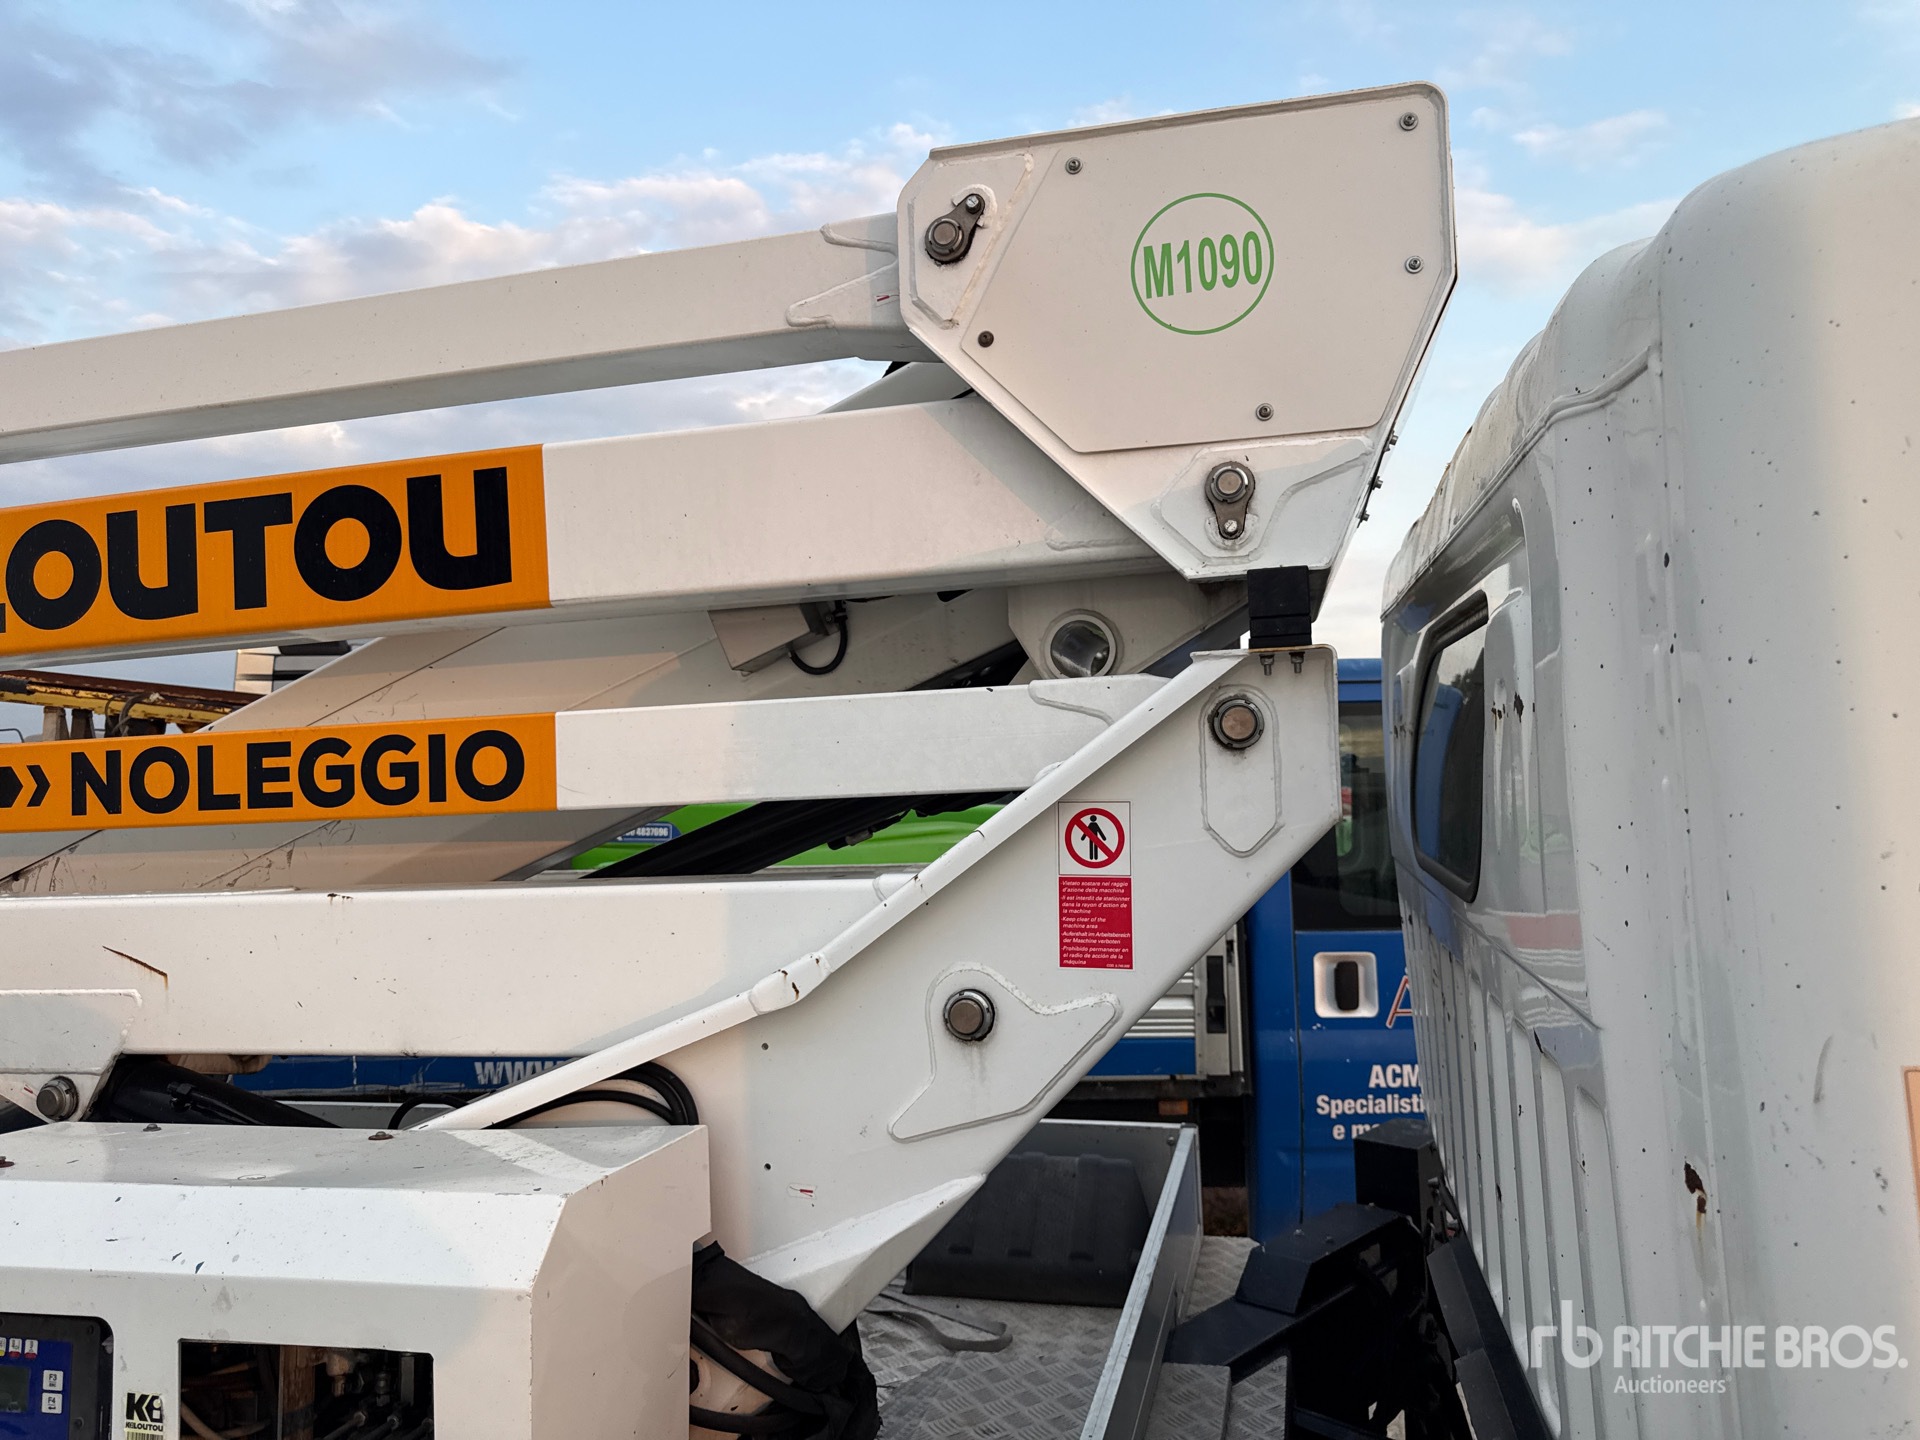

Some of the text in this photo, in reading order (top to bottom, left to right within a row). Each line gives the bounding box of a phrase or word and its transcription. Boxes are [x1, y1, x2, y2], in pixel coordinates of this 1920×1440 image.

[1143, 231, 1262, 299] M1090
[0, 466, 512, 633] OUTOU
[71, 730, 525, 816] NOLEGGIO
[1332, 1124, 1345, 1140] e
